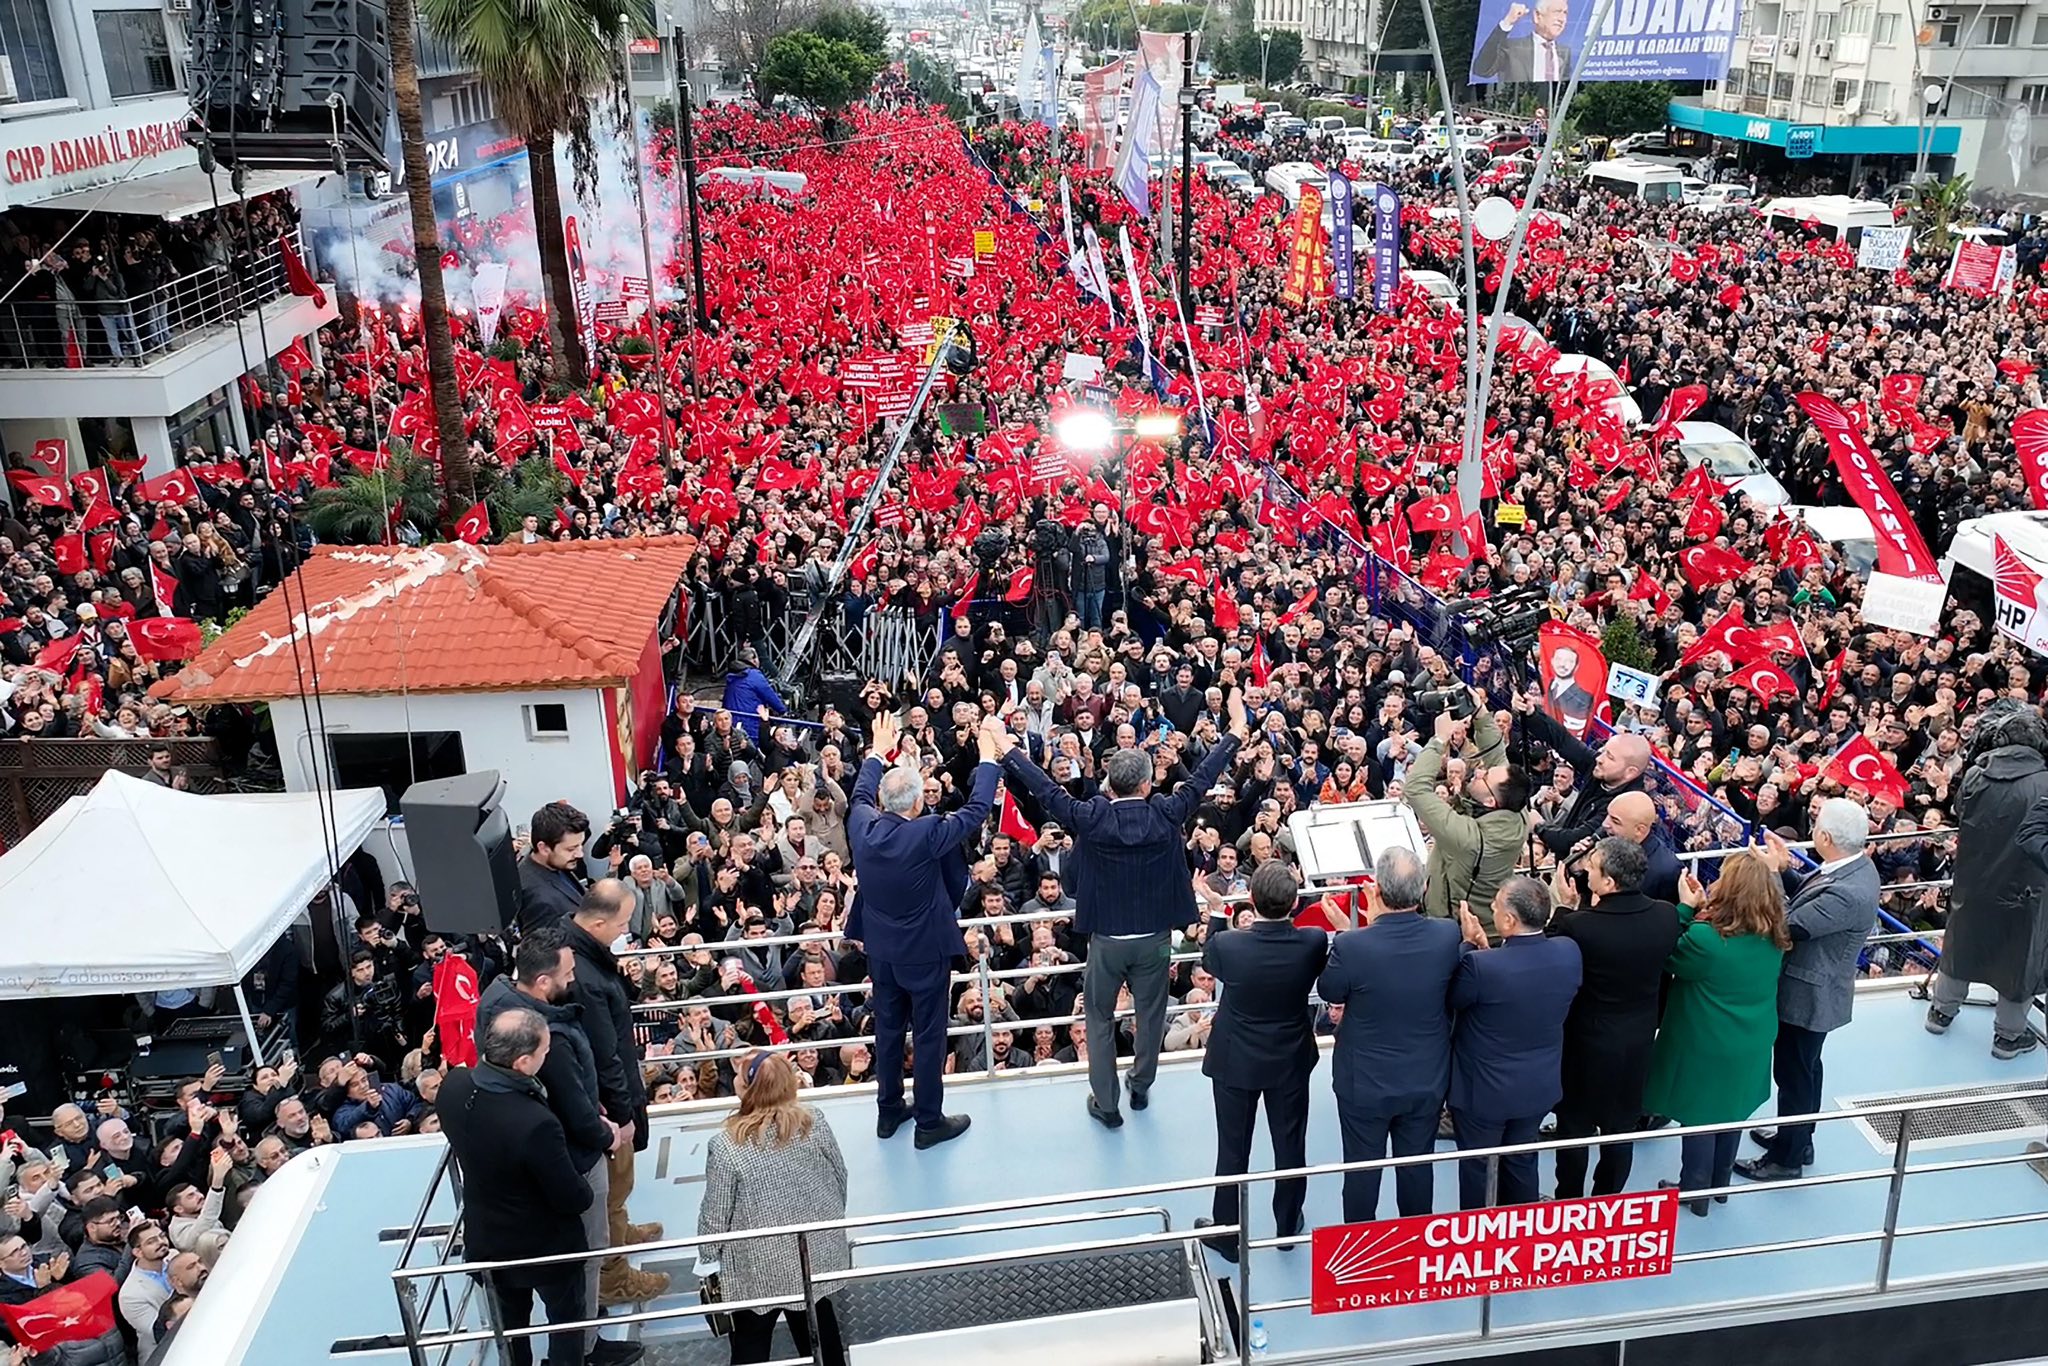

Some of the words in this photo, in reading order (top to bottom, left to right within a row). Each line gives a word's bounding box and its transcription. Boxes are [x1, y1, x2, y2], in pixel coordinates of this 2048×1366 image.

[1584, 39, 1636, 56] EYDAN
[6, 146, 46, 184] CHP
[50, 135, 112, 176] ADANA
[108, 125, 128, 162] İL
[1996, 596, 2026, 630] HP
[1424, 1195, 1668, 1248] CUMHURİYET
[1419, 1245, 1519, 1284] HALK
[1532, 1229, 1669, 1271] PARTİSİ
[1336, 1282, 1478, 1309] TÜRKİYE'NİN
[1489, 1269, 1572, 1290] BİRİNCİ
[1583, 1261, 1667, 1281] PARTİSİ
